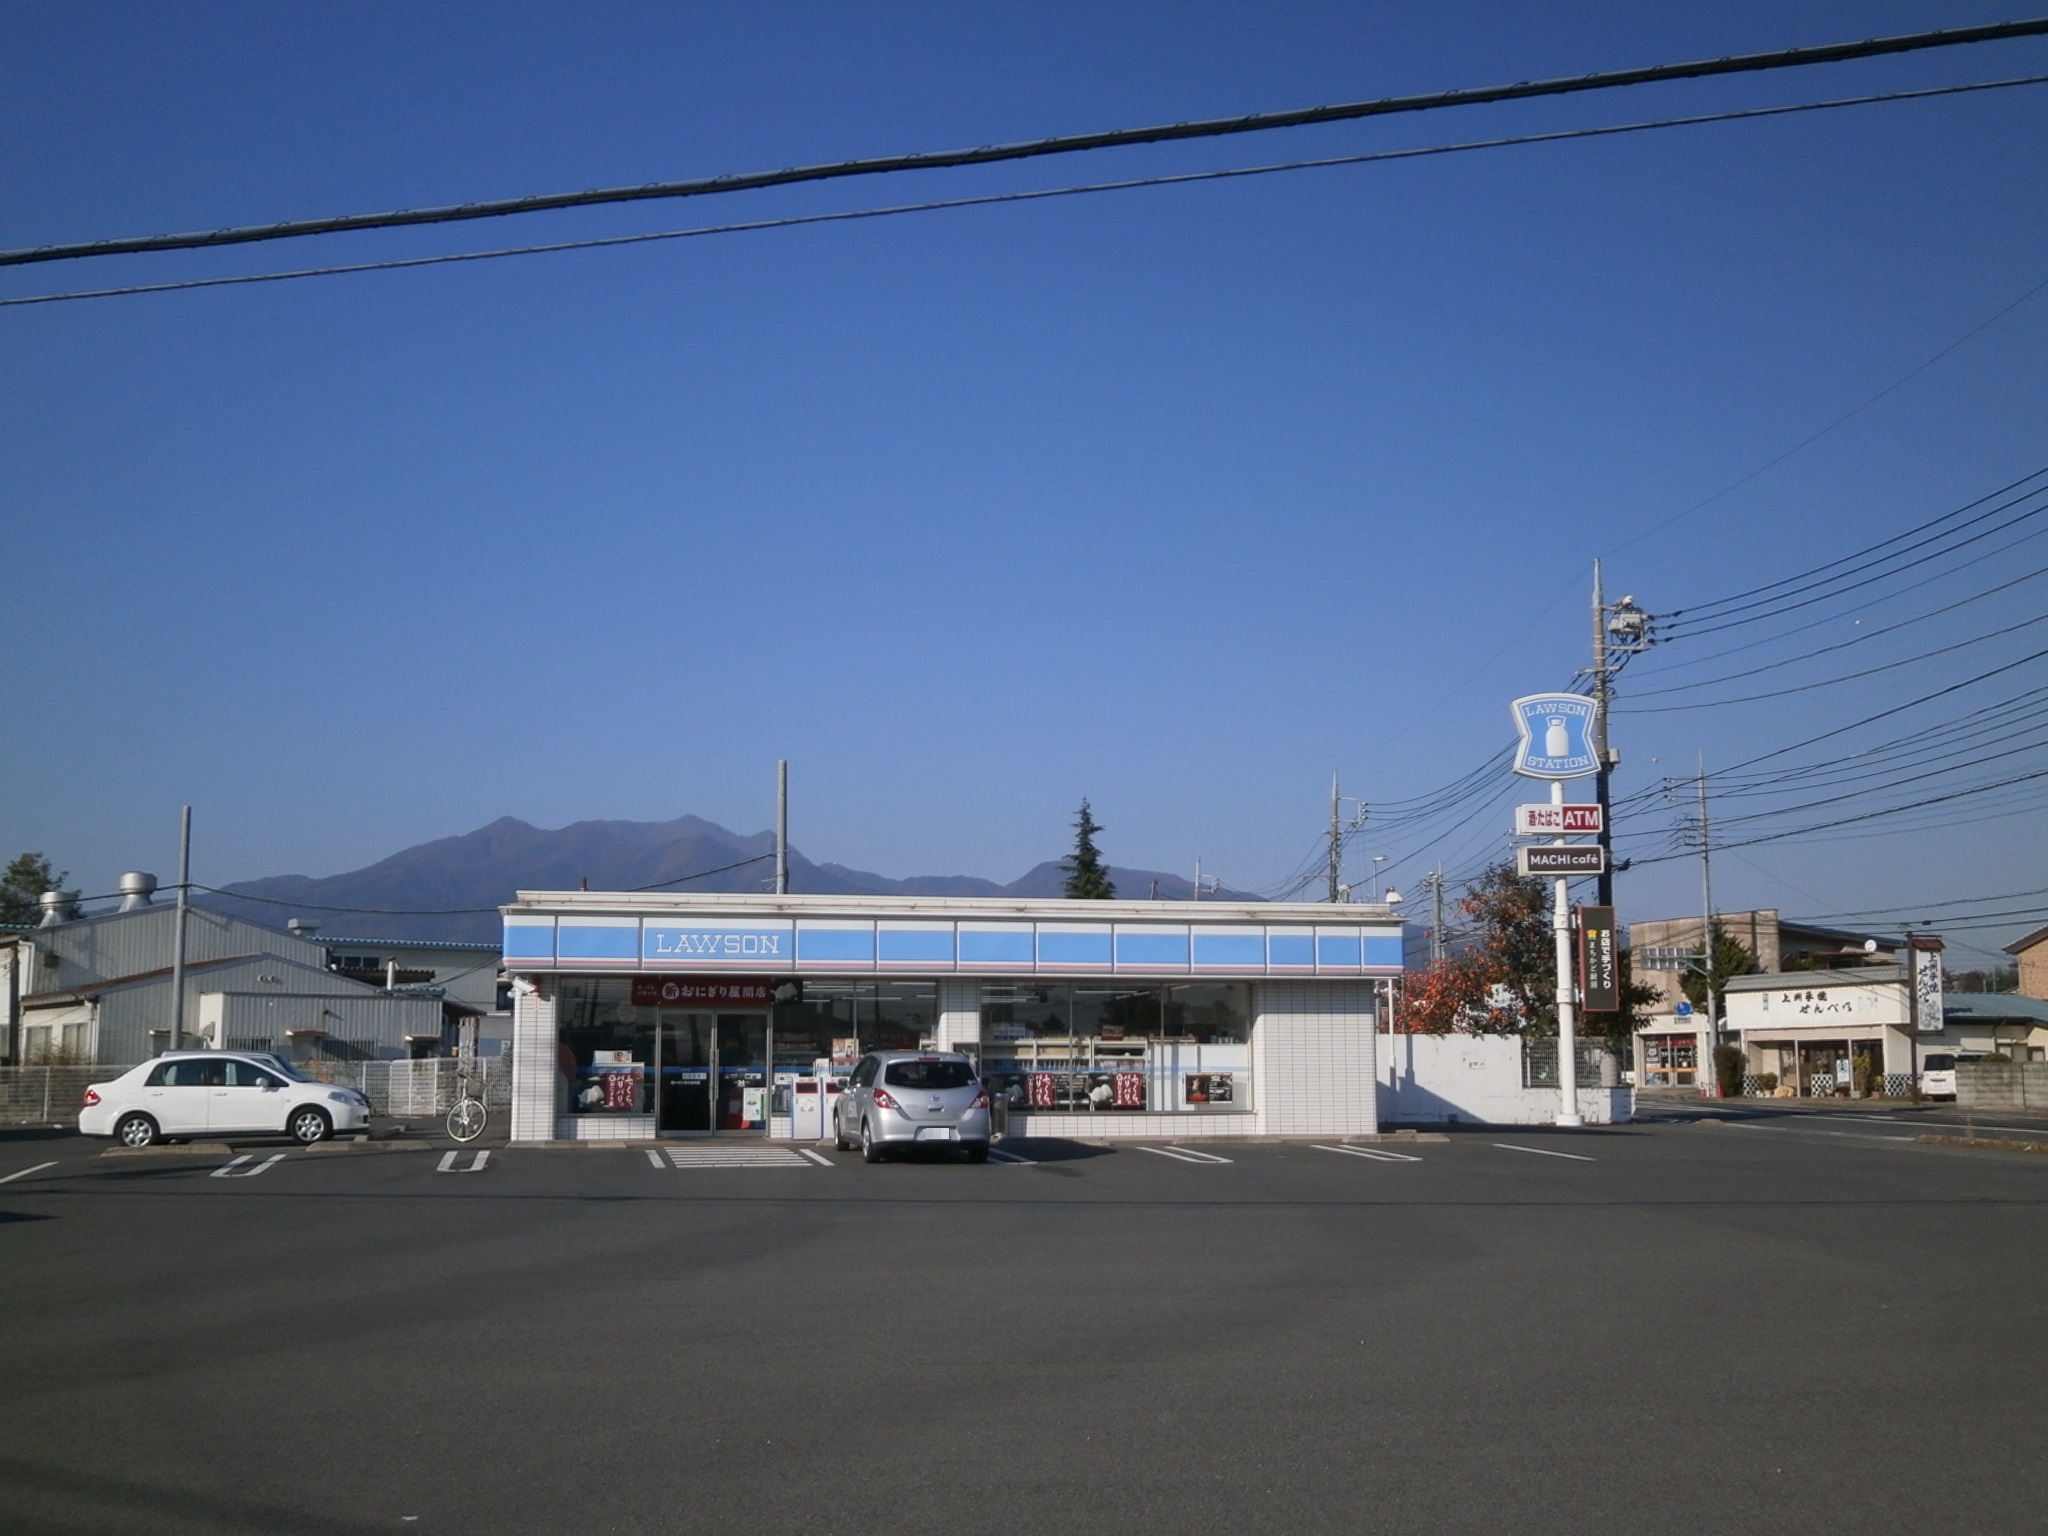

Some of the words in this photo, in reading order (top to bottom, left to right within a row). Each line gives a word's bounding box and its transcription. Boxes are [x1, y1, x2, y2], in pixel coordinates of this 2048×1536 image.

[1525, 703, 1587, 717] LAWSON
[1527, 755, 1590, 769] STATION
[1564, 810, 1599, 827] ATM
[1530, 854, 1571, 865] MACHI
[1572, 853, 1598, 864] café
[656, 933, 780, 954] LAWSON
